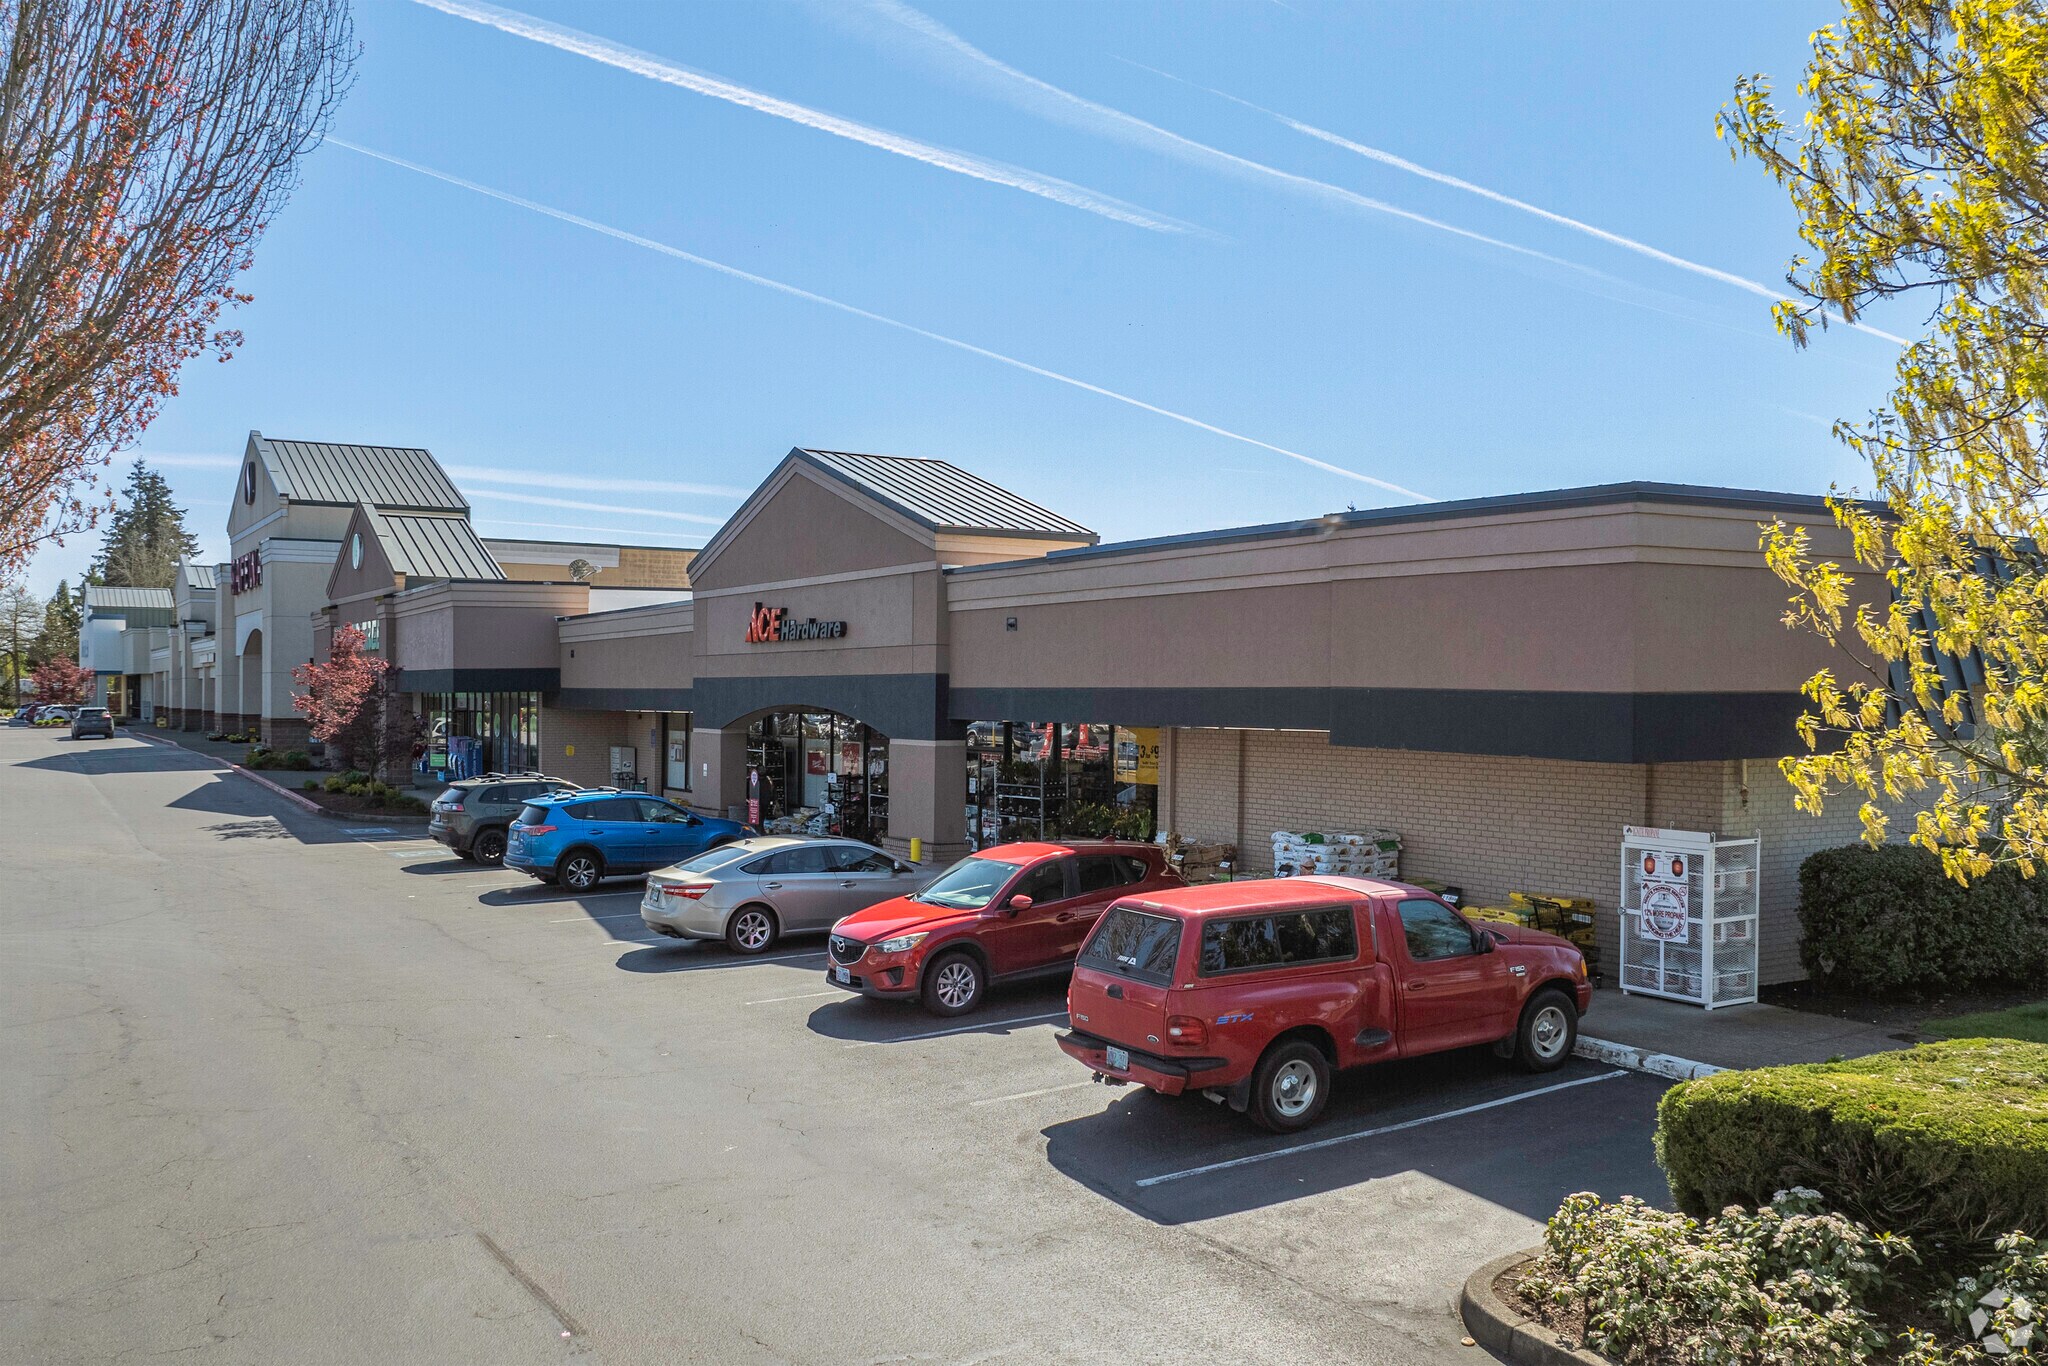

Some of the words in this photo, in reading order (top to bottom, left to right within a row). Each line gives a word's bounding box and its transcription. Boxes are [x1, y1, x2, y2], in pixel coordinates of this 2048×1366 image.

[745, 602, 783, 643] ACE
[781, 618, 844, 641] Hardware
[1140, 745, 1146, 759] 3
[1653, 909, 1665, 918] MORE
[1665, 910, 1685, 921] PROPANE
[1216, 1012, 1254, 1025] STX
